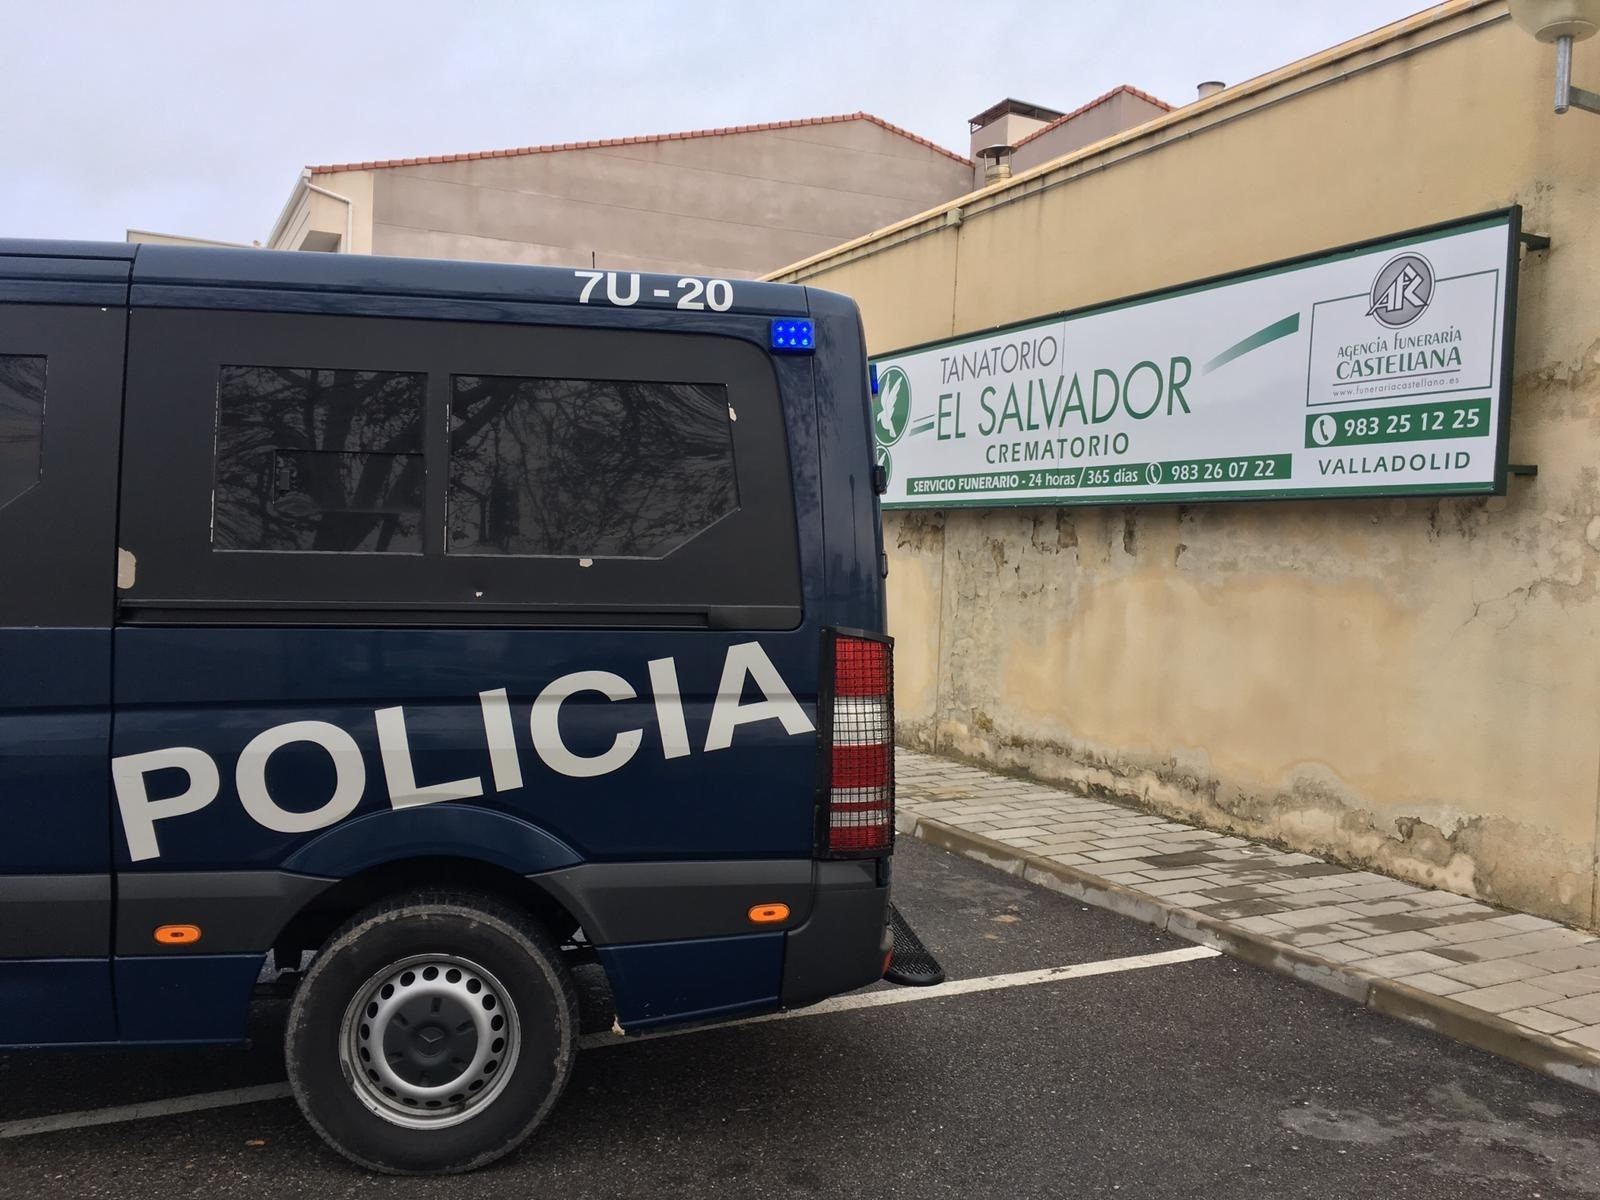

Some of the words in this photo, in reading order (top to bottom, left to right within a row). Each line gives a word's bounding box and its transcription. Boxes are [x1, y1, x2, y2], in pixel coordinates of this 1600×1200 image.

[574, 271, 641, 306] 7U
[676, 278, 734, 312] 20
[1337, 336, 1388, 360] AGENCIA
[1394, 325, 1462, 350] FUNERARIA
[940, 335, 1057, 384] TANATORIO
[1336, 346, 1462, 380] CASTELLANA
[937, 391, 966, 440] EL
[978, 356, 1192, 436] SALVADOR
[1332, 376, 1460, 397] www.funerariacastellana.es
[1344, 417, 1379, 437] 983
[1386, 414, 1411, 434] 25
[1421, 411, 1444, 431] 12
[1452, 408, 1480, 428] 25
[985, 432, 1130, 464] CREMATORIO
[1318, 452, 1471, 476] VALLADOLID
[913, 479, 956, 493] SERVICIO
[958, 474, 1019, 491] FUNERARIO
[1028, 473, 1042, 487] 24
[1113, 467, 1139, 484] días
[1171, 465, 1199, 481] 983
[1203, 463, 1223, 479] 26
[1228, 461, 1248, 478] 07
[1254, 460, 1275, 477] 22
[112, 641, 816, 863] POLICIA
